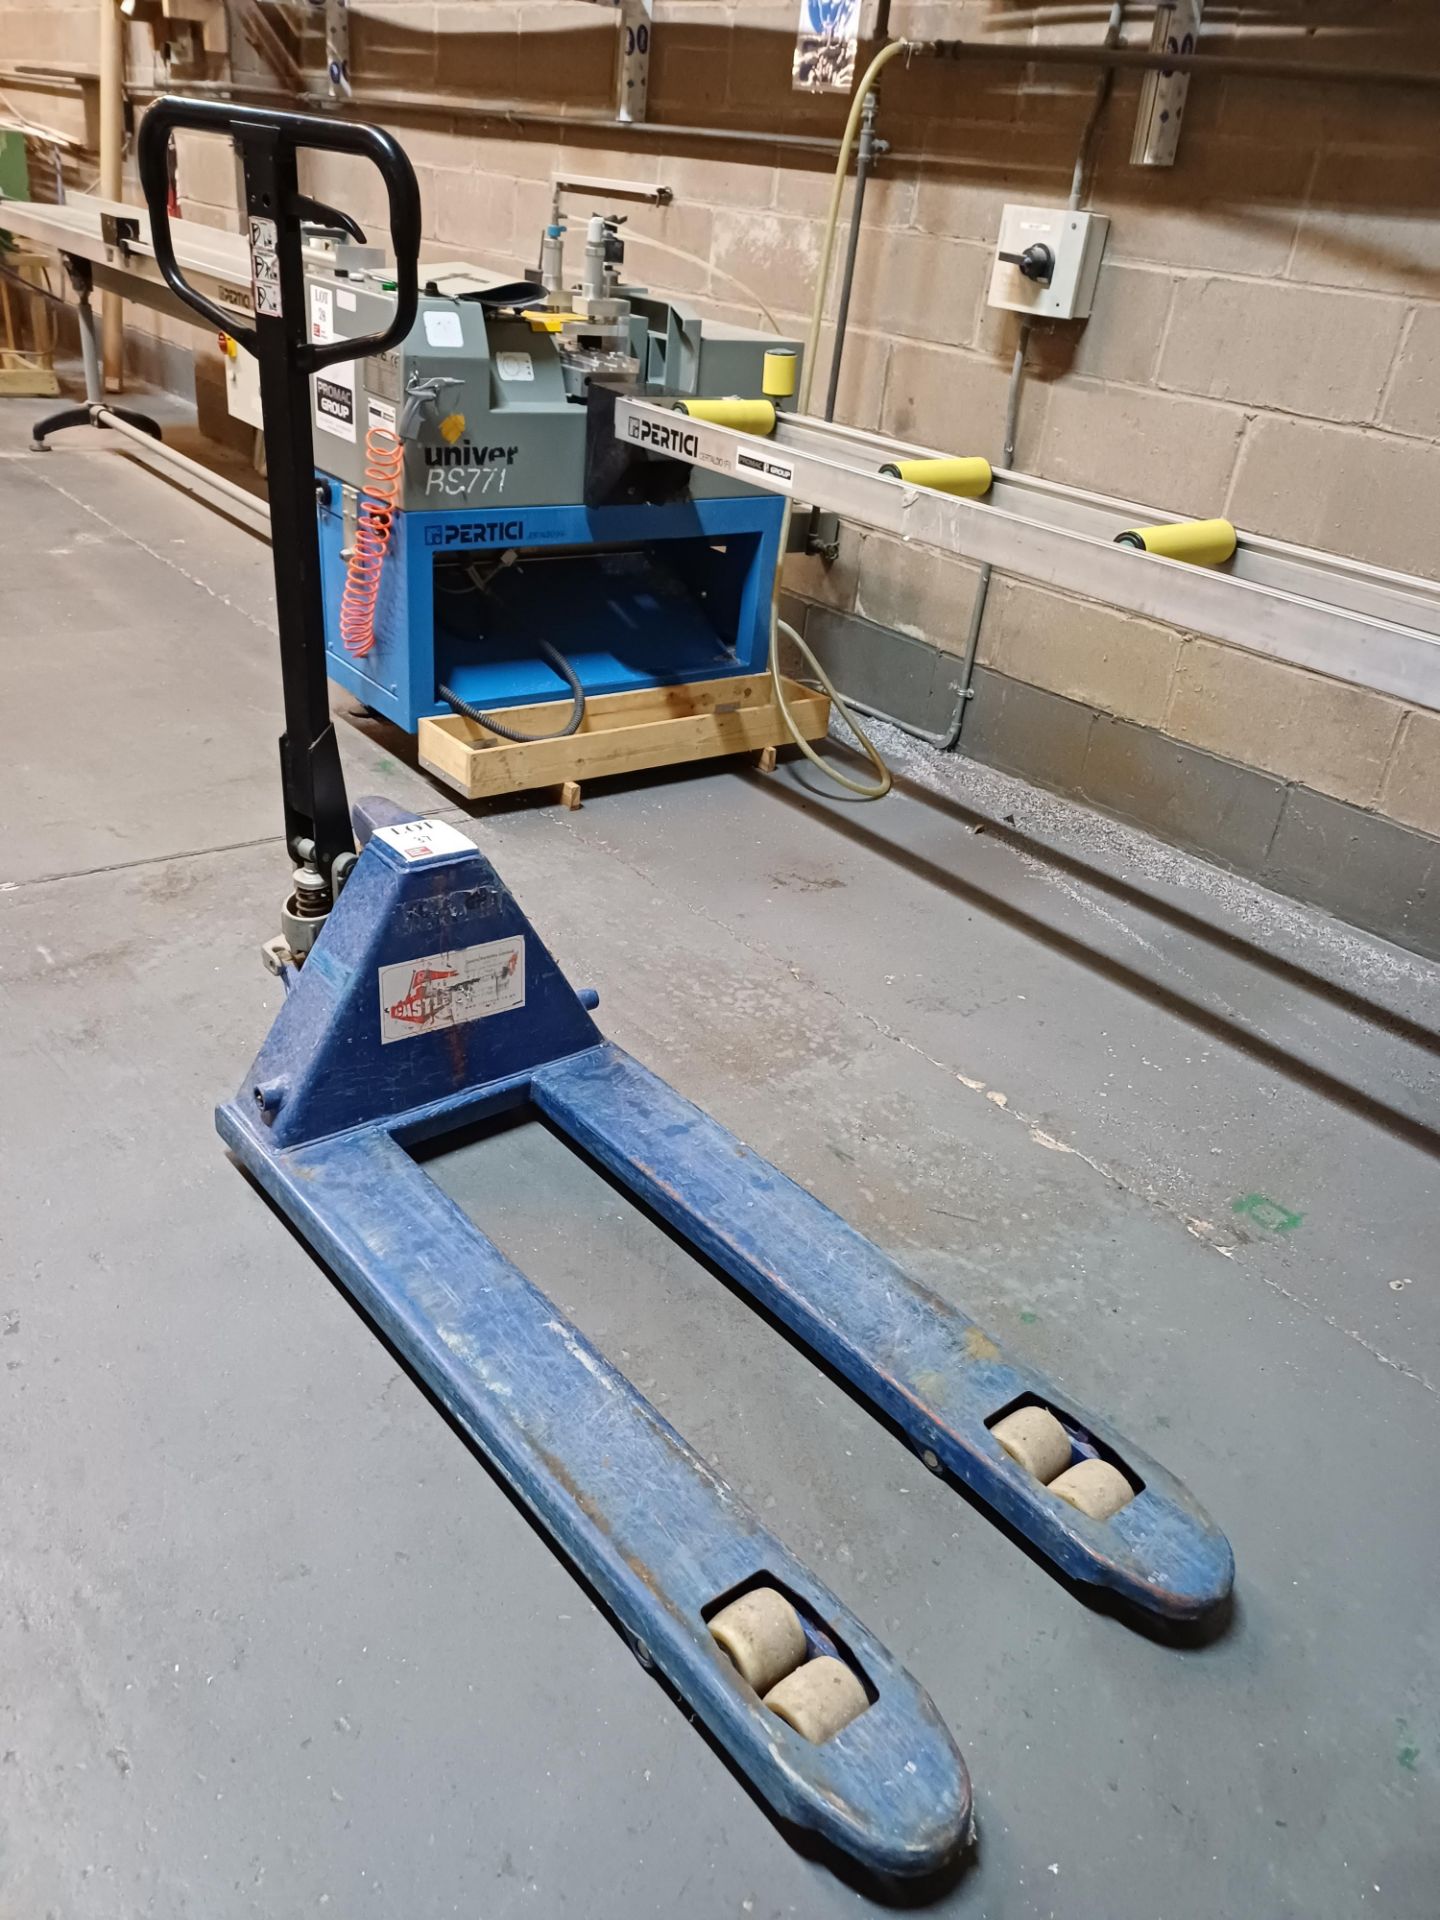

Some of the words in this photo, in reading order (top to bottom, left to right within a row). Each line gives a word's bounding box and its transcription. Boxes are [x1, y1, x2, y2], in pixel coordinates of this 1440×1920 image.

[314, 288, 329, 304] LOT
[317, 381, 351, 404] PROMAC
[321, 397, 350, 419] GROUP
[641, 419, 699, 458] PERTICI
[424, 439, 518, 466] univer
[425, 467, 506, 495] RS771
[769, 465, 791, 479] GROUP
[445, 521, 523, 545] PERTICI
[390, 820, 434, 835] LOT
